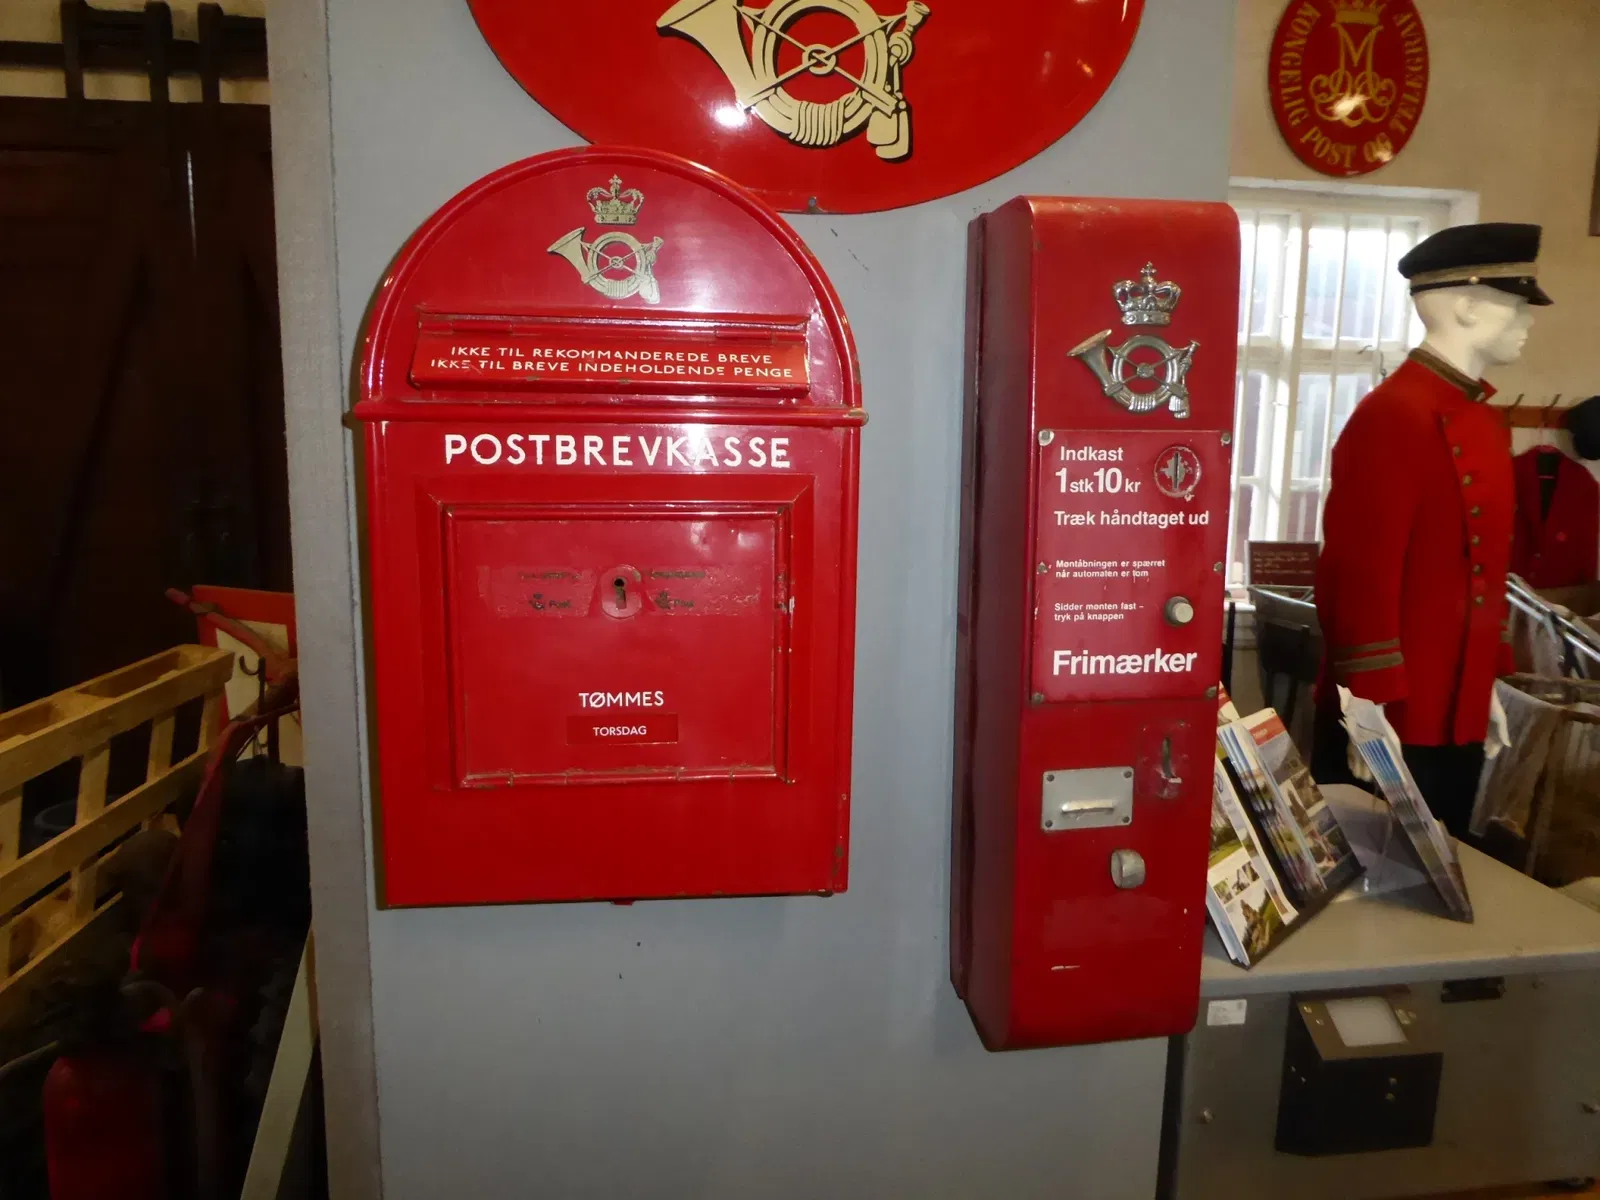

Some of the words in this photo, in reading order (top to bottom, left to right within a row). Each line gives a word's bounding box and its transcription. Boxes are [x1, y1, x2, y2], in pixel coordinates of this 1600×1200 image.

[1279, 3, 1321, 126] KONGELIG
[1300, 126, 1357, 167] POST
[451, 346, 491, 357] IKKE
[498, 347, 525, 357] TIL
[532, 348, 709, 363] REKOMMANDEREDE
[718, 353, 773, 364] BREVE
[430, 359, 471, 369] IKKE
[478, 360, 505, 370] TIL
[512, 361, 570, 372] BREVE
[578, 362, 725, 376] INDEHOLDENDE
[734, 367, 793, 377] PENGE
[445, 432, 791, 468] POSTBREVKASSE
[1060, 446, 1124, 462] Indkast
[1054, 510, 1096, 526] Træk
[1100, 509, 1185, 529] håndtaget
[1189, 510, 1209, 526] ud
[1120, 560, 1130, 568] er
[1132, 559, 1166, 569] spærret
[1055, 569, 1070, 578] når
[1072, 569, 1119, 578] automaten
[1120, 570, 1130, 578] er
[1132, 569, 1149, 577] tom
[1054, 602, 1083, 611] Sidder
[1120, 602, 1136, 610] fast
[1054, 613, 1071, 622] tryk
[1073, 611, 1085, 622] på
[1087, 612, 1124, 622] knappen
[1053, 648, 1197, 676] Frimærker
[578, 690, 665, 708] TØMMES
[592, 725, 647, 737] TORSDAG
